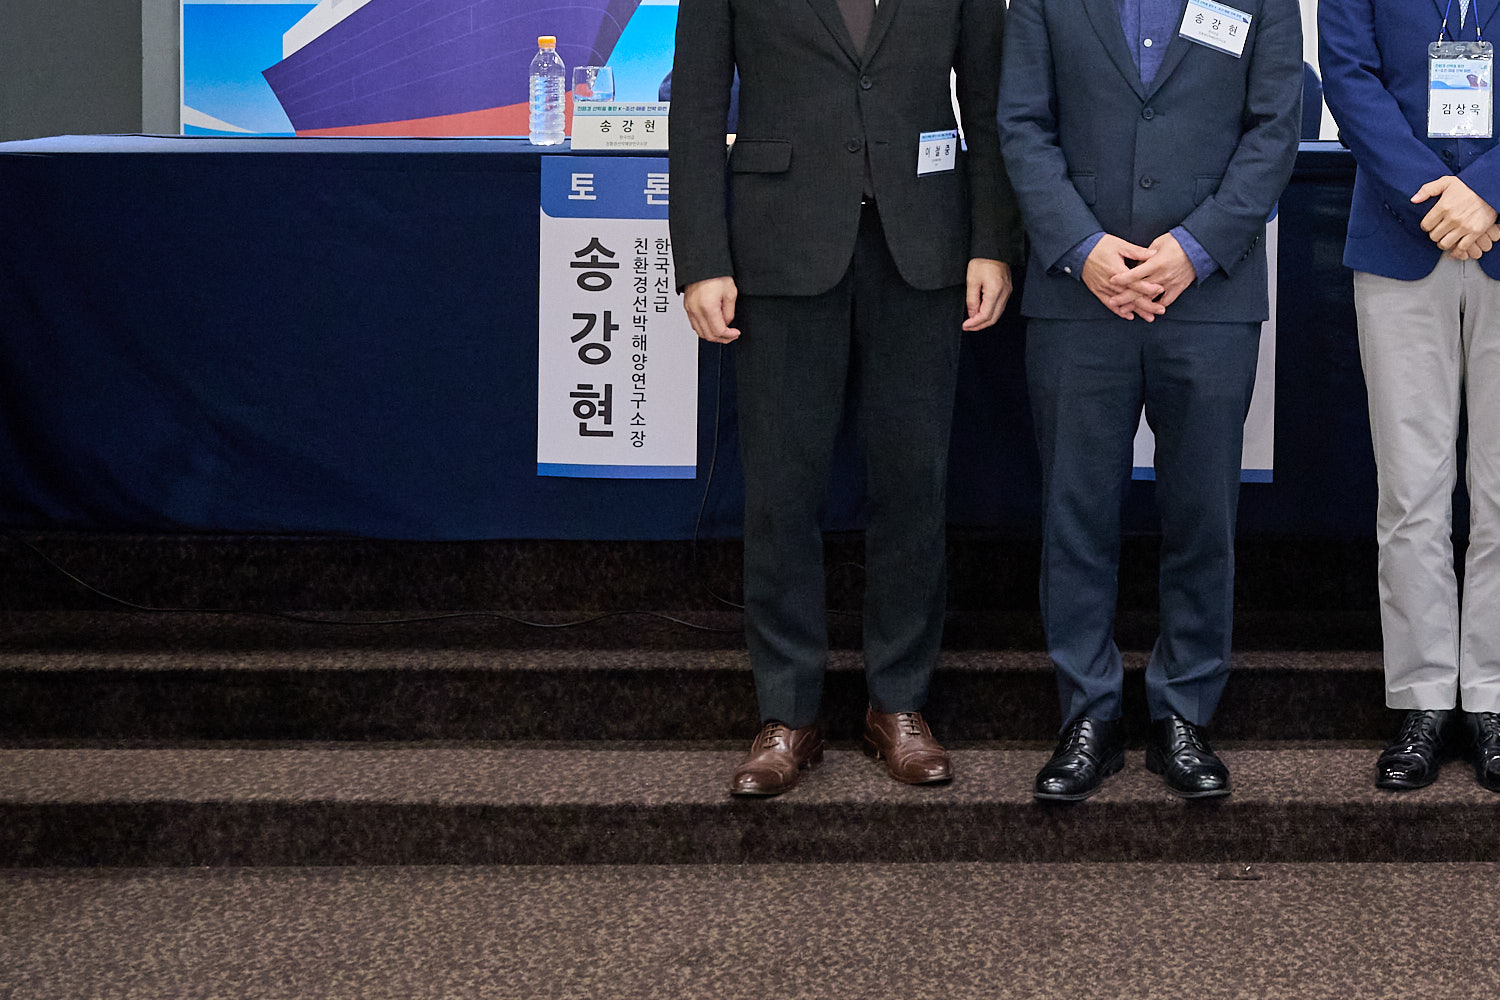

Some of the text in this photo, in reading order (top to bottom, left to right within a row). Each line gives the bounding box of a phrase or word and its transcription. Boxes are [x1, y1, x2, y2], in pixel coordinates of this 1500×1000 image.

[569, 237, 620, 438] 송강현
[629, 238, 649, 448] 친환경선박해양연구소장
[653, 238, 671, 313] 한국선급
